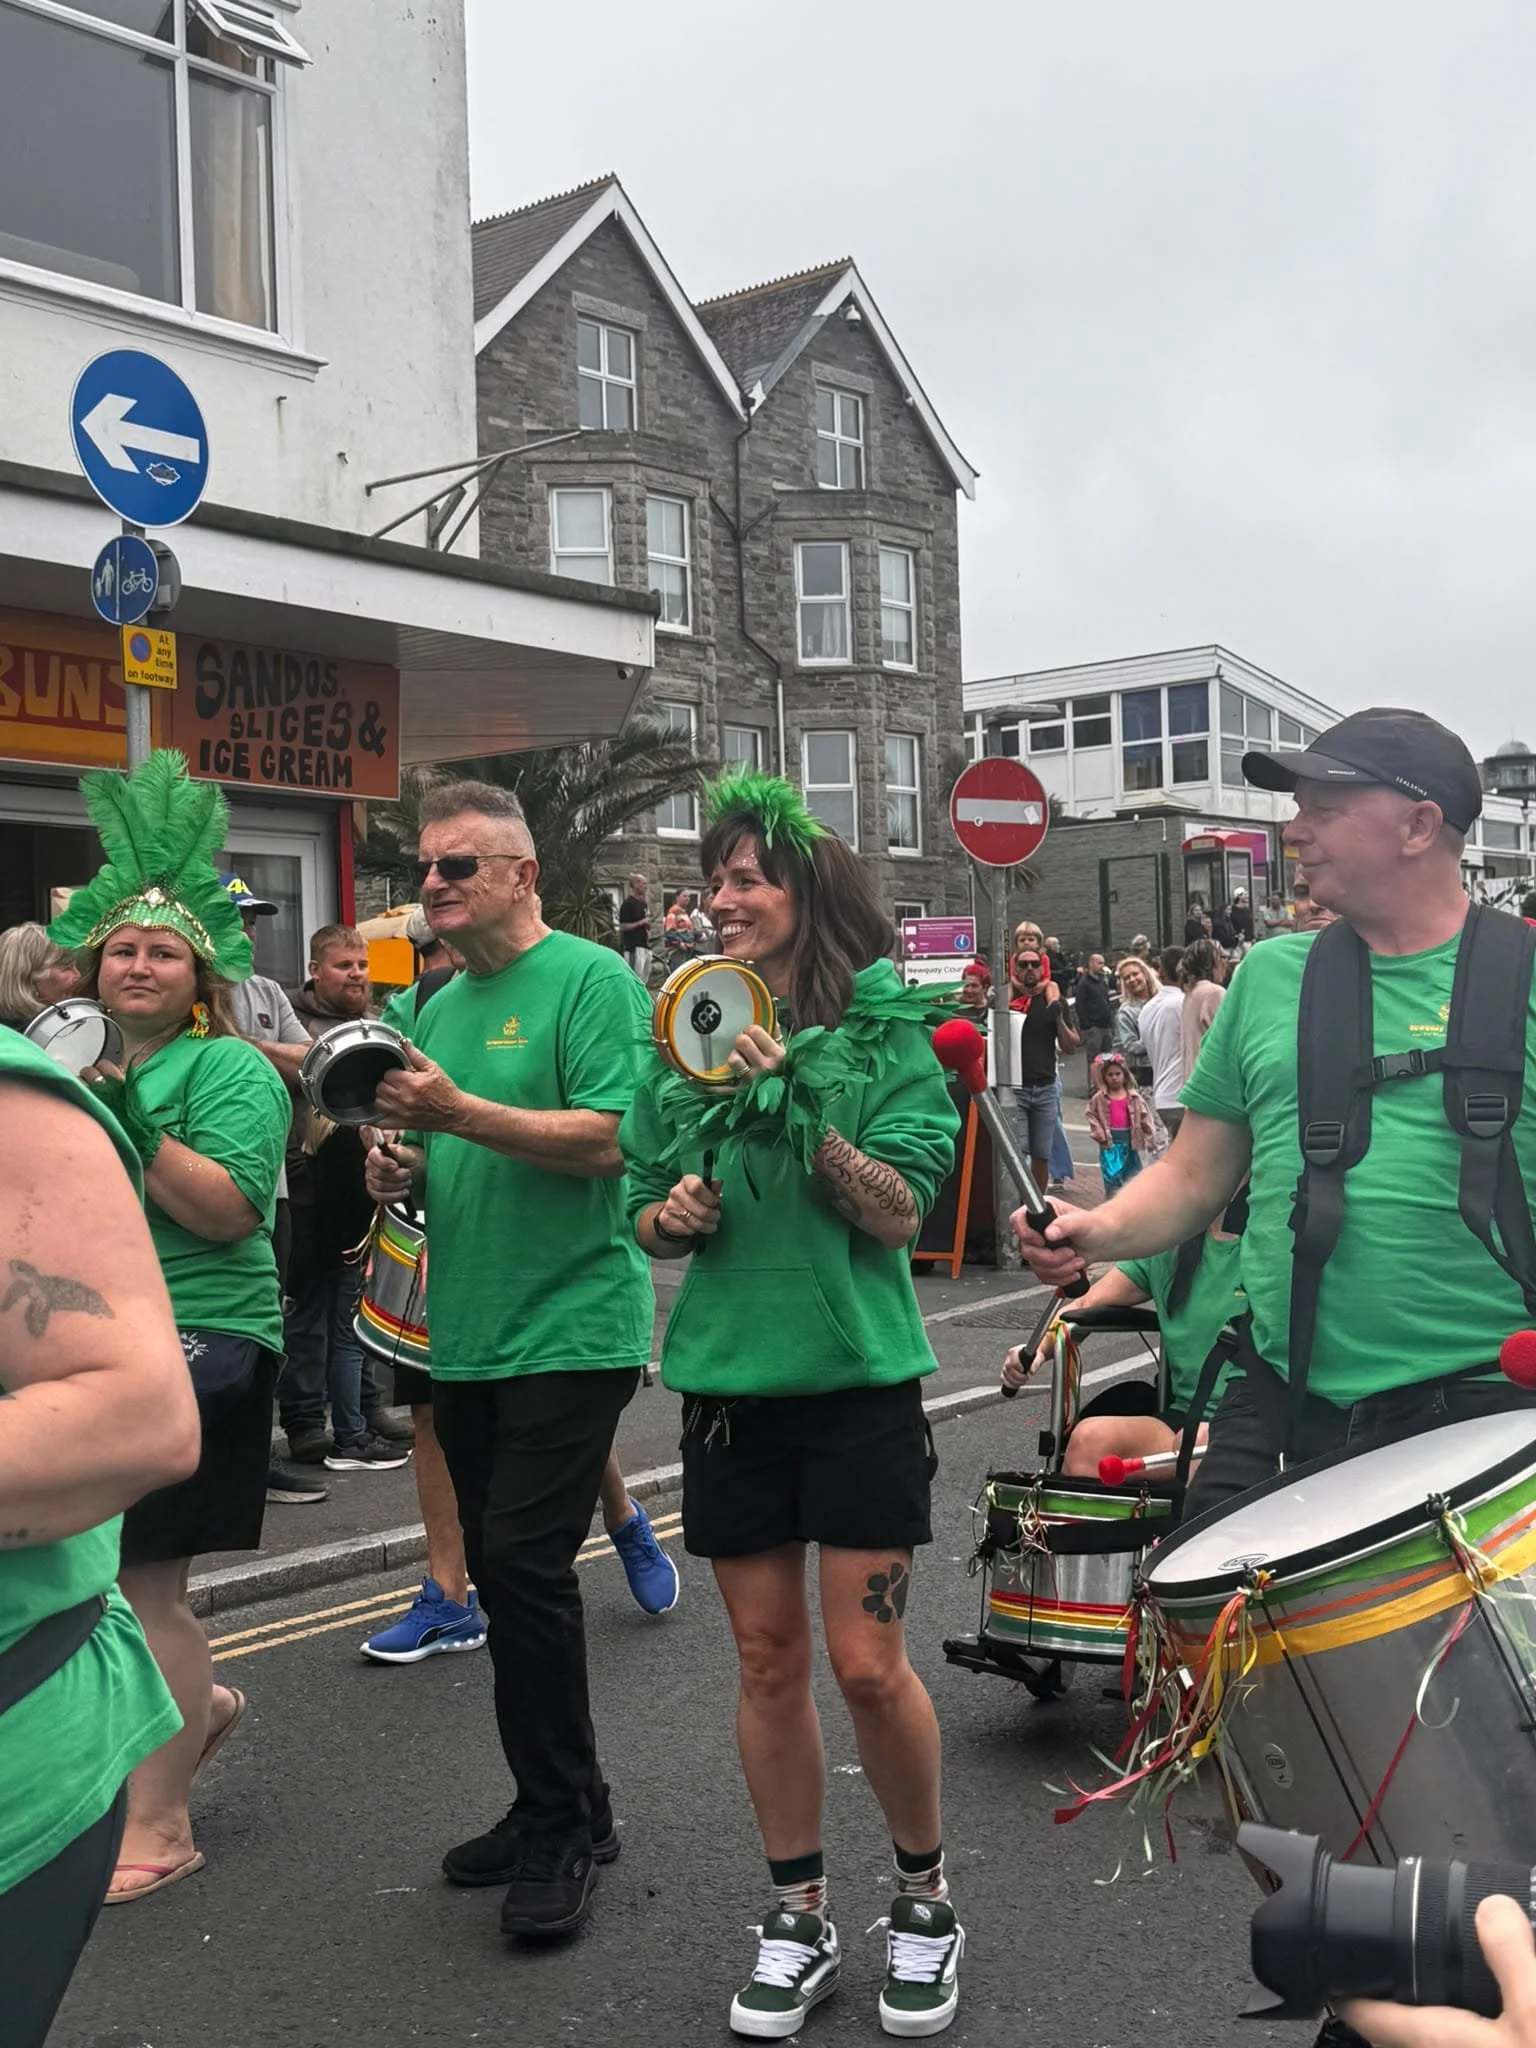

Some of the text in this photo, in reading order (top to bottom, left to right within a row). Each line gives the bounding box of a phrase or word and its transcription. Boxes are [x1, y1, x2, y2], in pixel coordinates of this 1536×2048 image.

[159, 634, 169, 645] At
[156, 647, 171, 658] any
[155, 657, 174, 669] time
[127, 670, 173, 685] on footway
[200, 739, 250, 779] ICE
